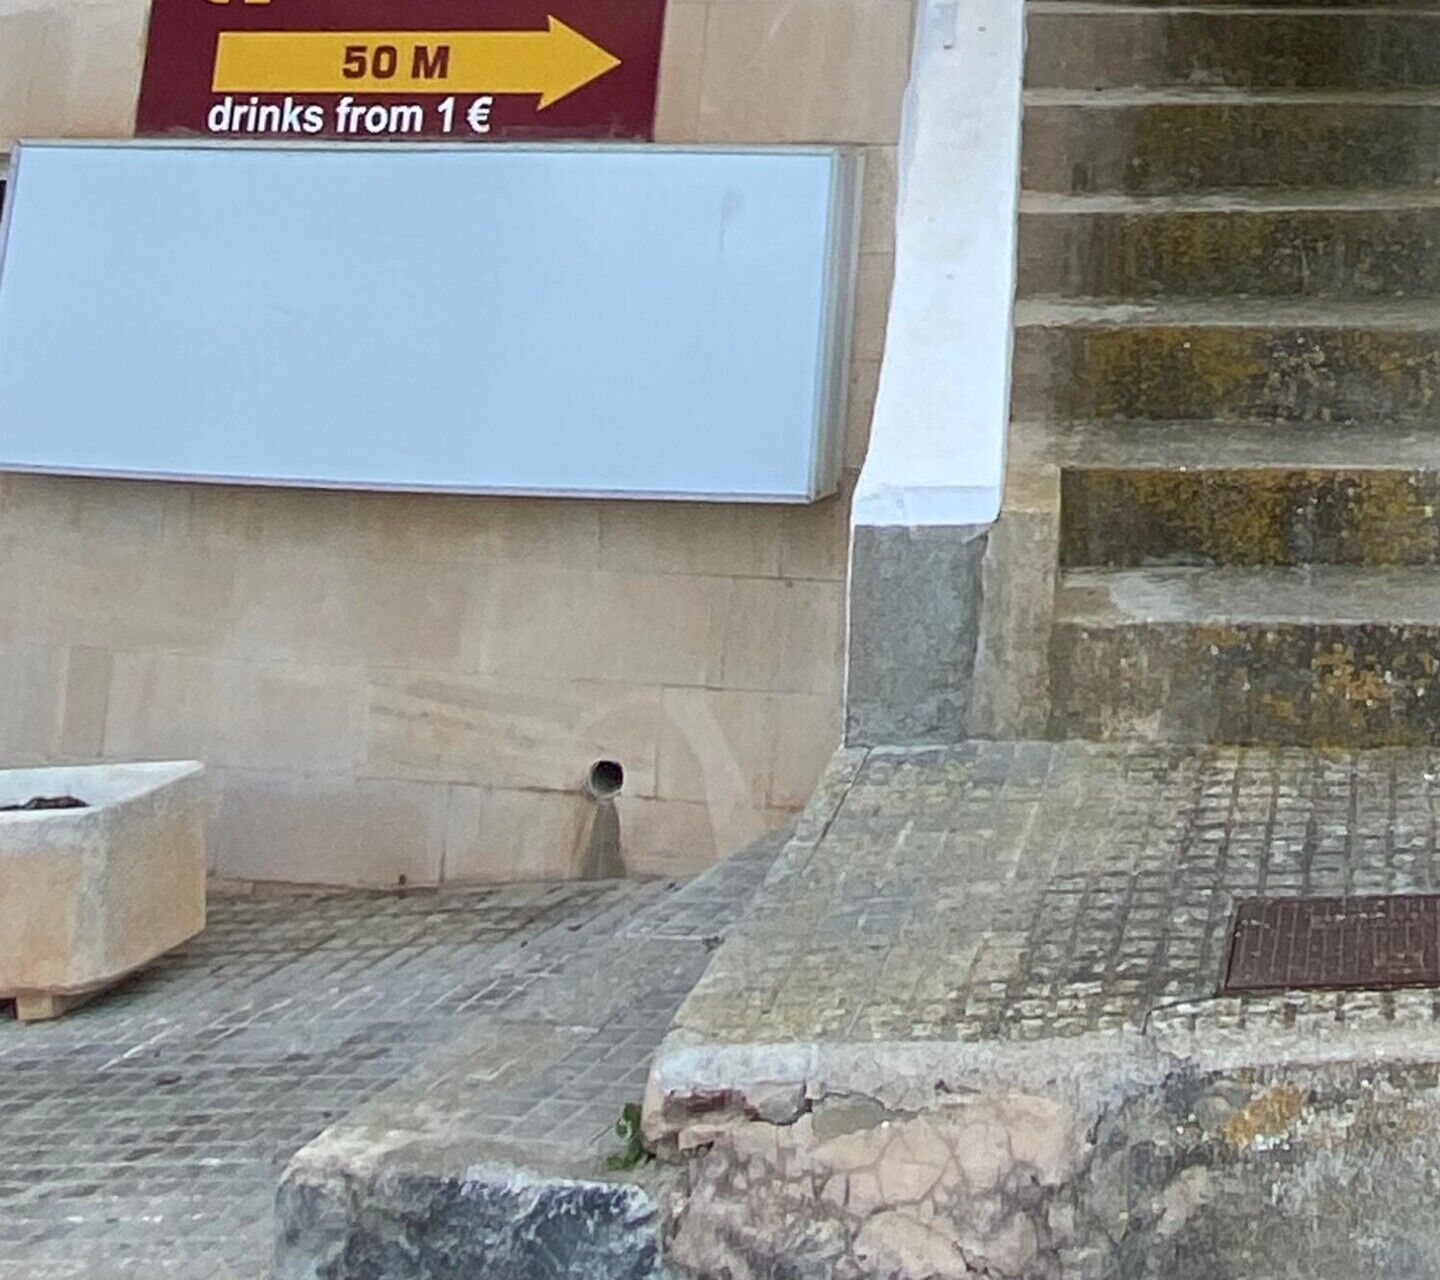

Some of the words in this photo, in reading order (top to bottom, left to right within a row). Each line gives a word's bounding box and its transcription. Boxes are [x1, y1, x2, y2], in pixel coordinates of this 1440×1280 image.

[342, 44, 398, 79] 50
[411, 44, 451, 79] M
[206, 95, 324, 133] drinks
[335, 95, 424, 133] from
[437, 96, 457, 133] 1
[467, 96, 494, 133] €
